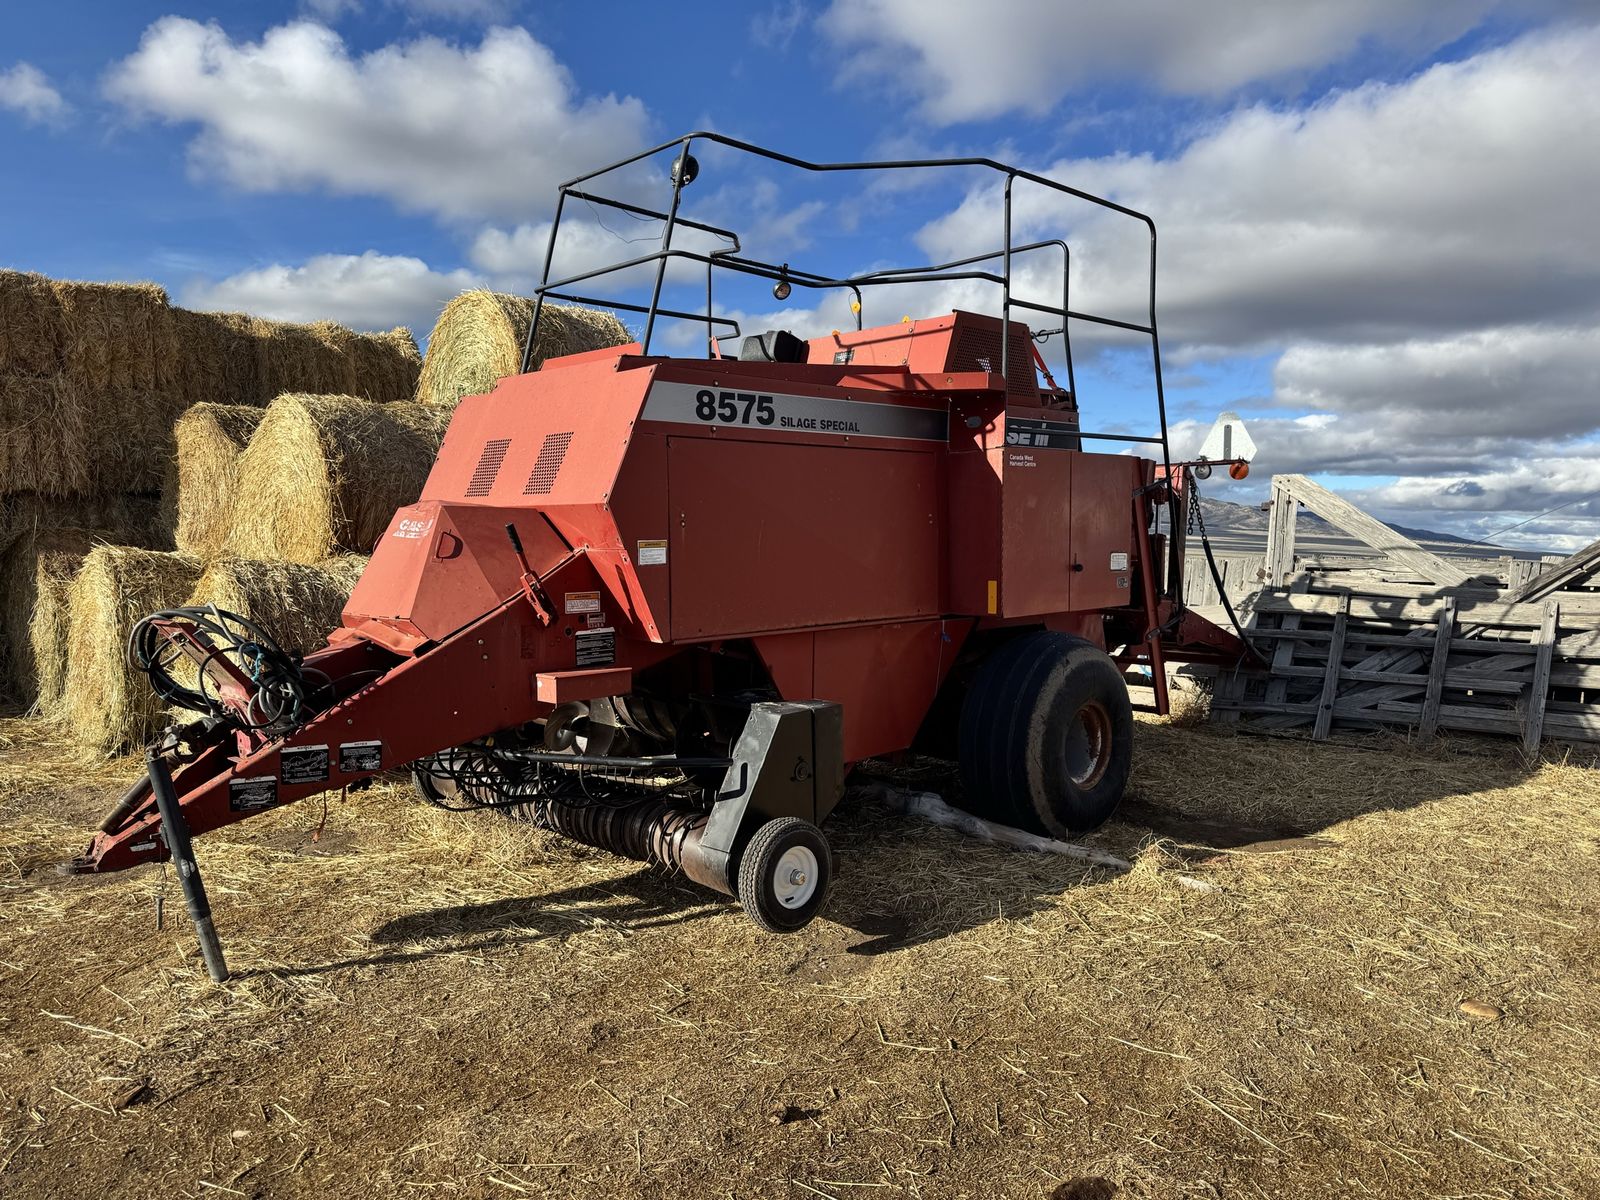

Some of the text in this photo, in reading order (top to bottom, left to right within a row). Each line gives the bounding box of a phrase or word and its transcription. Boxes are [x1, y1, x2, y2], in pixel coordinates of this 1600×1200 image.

[696, 390, 860, 432] 8575 SILAGE SPECIAL
